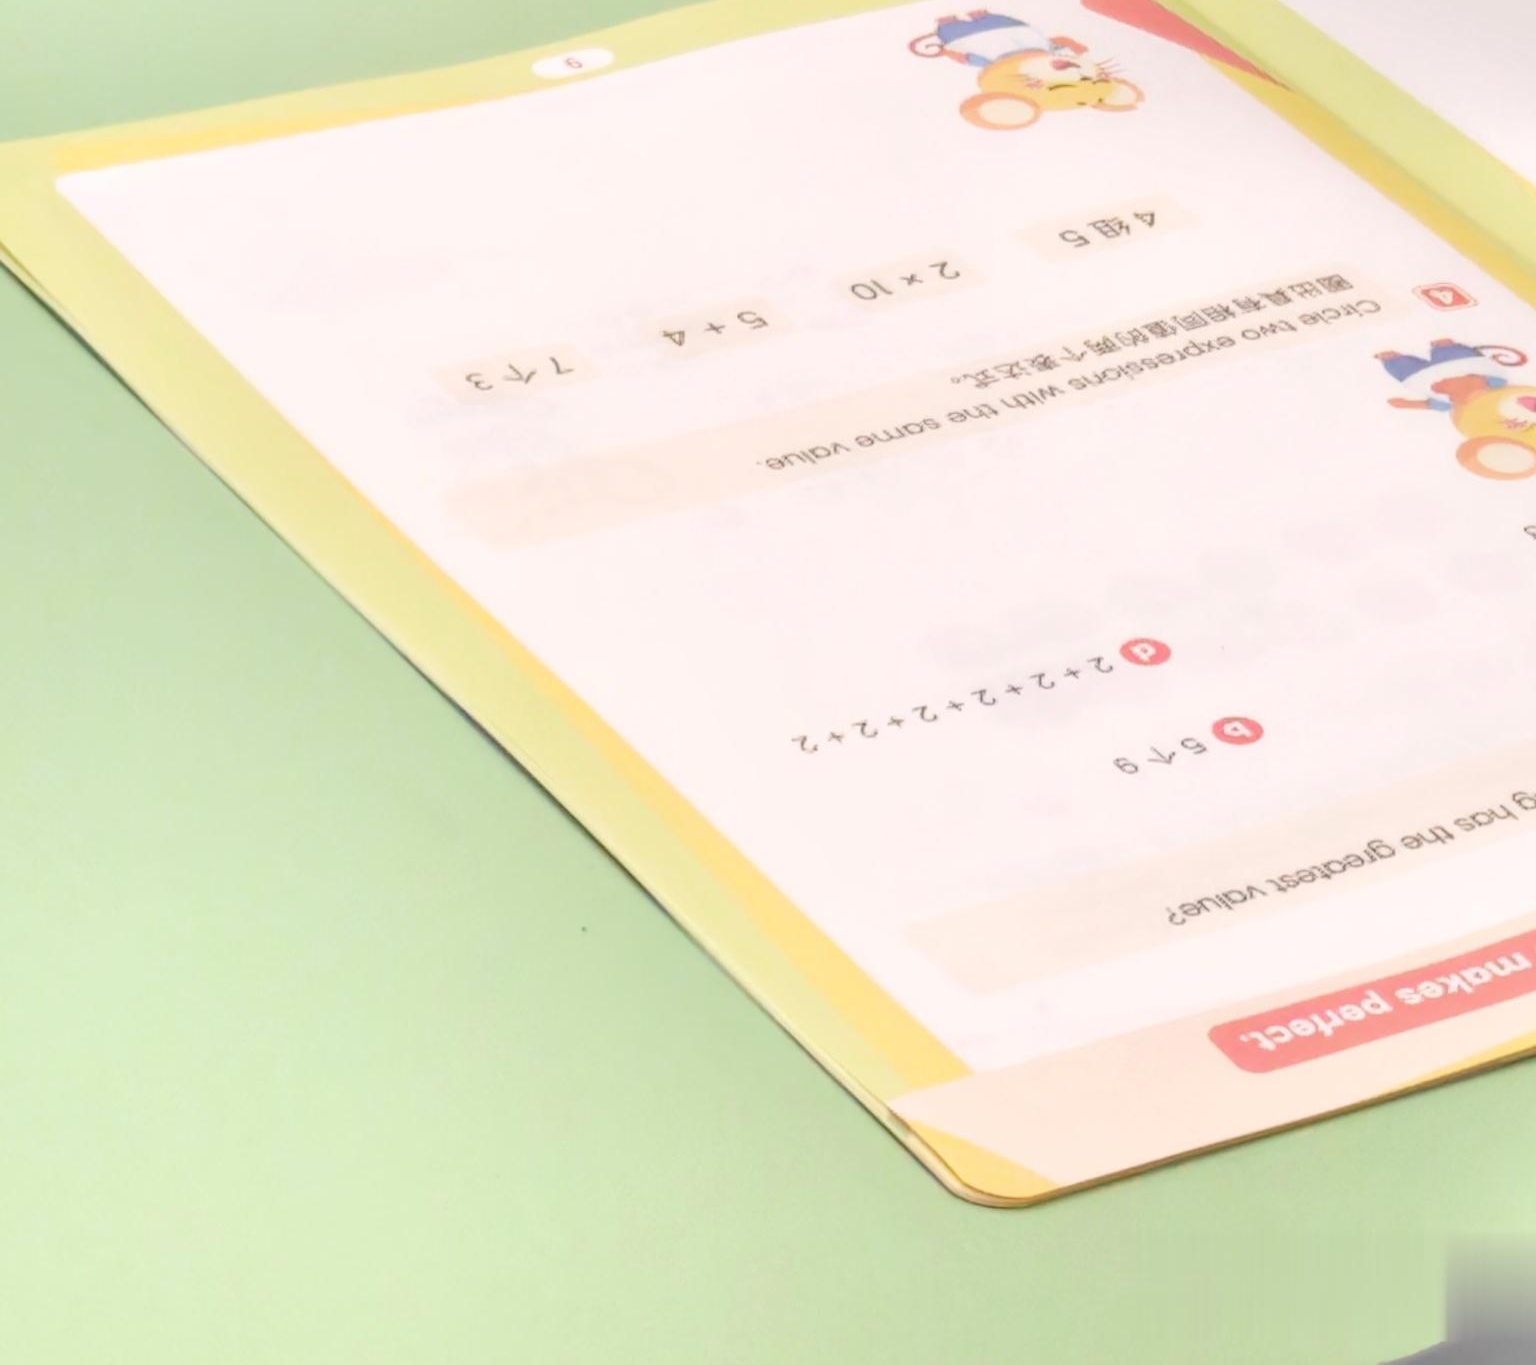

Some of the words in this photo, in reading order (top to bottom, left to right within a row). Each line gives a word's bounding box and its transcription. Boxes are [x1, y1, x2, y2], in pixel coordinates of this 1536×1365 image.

[1058, 227, 1090, 248] 5
[928, 261, 961, 280] 2
[849, 279, 892, 302] 10
[735, 310, 769, 329] 5
[1297, 298, 1382, 329] Circle
[662, 326, 686, 347] 4
[1241, 320, 1297, 342] two
[546, 356, 575, 375] 7
[1067, 338, 1236, 392] expressions
[464, 373, 494, 392] 3
[1000, 385, 1065, 409] with
[947, 403, 998, 425] the
[855, 418, 940, 448] same
[756, 441, 851, 471] value.
[1086, 656, 1113, 675] 2
[1028, 672, 1056, 690] 2
[970, 688, 997, 707] 2
[911, 704, 938, 723] 2
[851, 720, 878, 739] 2
[791, 735, 818, 755] 2
[1180, 736, 1208, 756] 5
[1112, 757, 1140, 776] 9
[1454, 803, 1518, 835] has
[1400, 824, 1454, 851] the
[1266, 839, 1396, 895] greatest
[1164, 883, 1268, 927] value?
[1394, 951, 1533, 1008] makes
[1238, 989, 1394, 1054] perfect.
